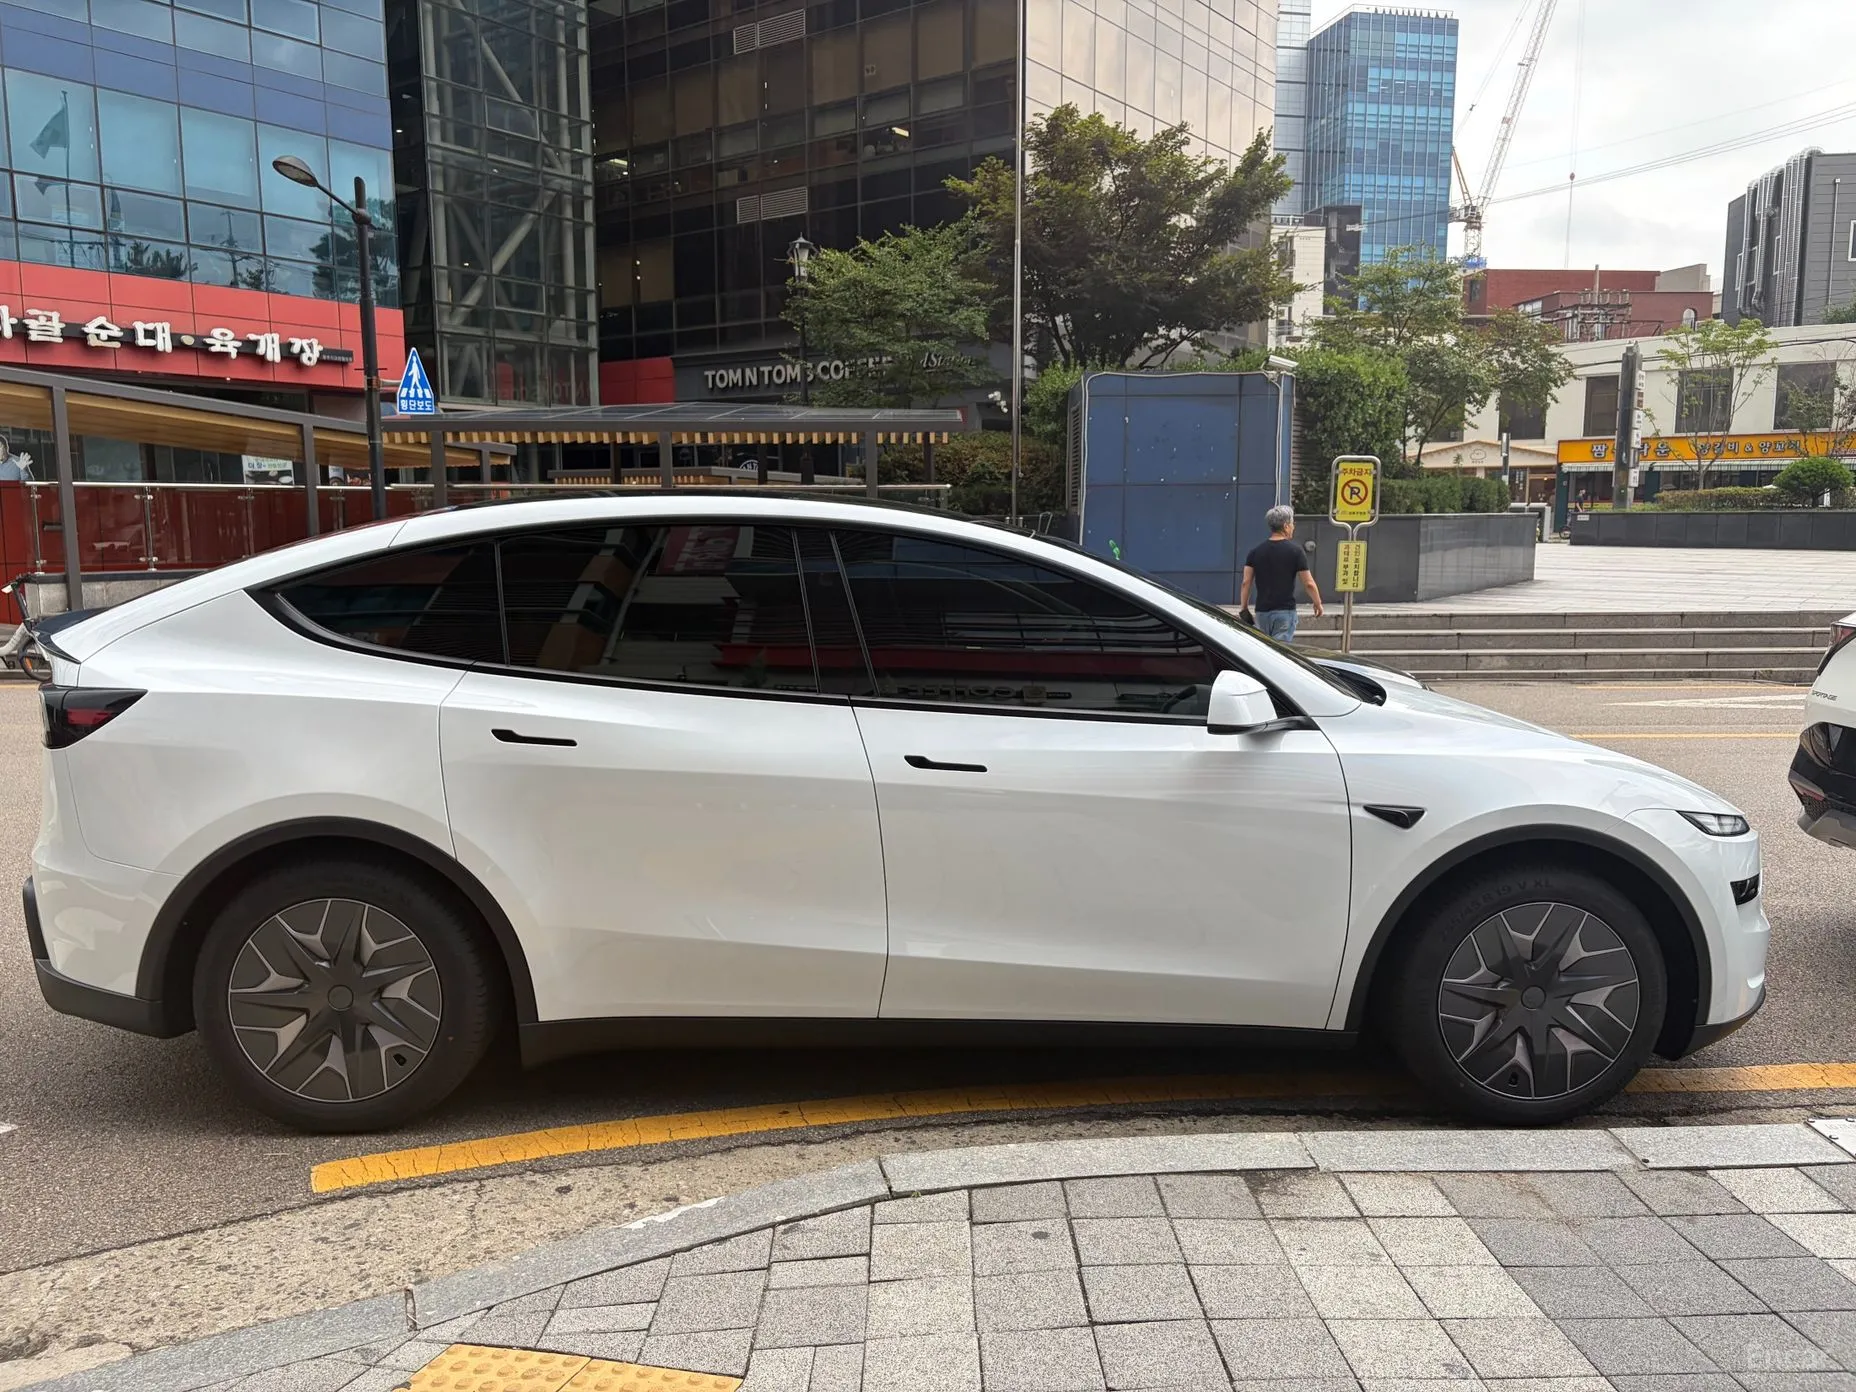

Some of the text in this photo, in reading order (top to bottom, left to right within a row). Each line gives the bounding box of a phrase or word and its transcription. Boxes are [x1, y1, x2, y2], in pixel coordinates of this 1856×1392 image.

[703, 368, 743, 389] TOM
[745, 366, 758, 386] N
[400, 399, 433, 411] 횡단보도
